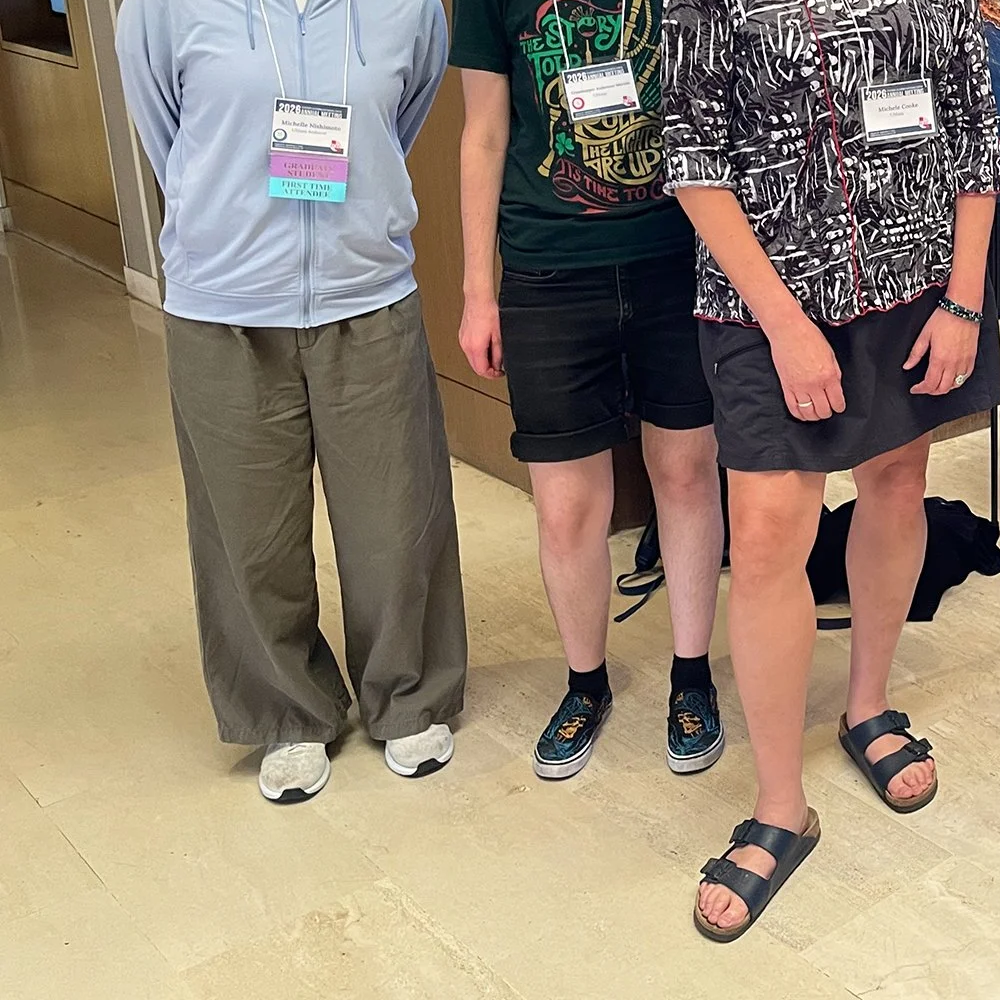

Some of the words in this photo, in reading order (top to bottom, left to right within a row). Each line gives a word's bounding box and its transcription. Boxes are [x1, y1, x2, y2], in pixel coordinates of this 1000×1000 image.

[519, 37, 545, 54] THE
[567, 72, 587, 83] 2026
[867, 89, 887, 100] 2026
[278, 102, 301, 115] 2026
[281, 119, 309, 128] Michelle
[575, 134, 611, 161] THE
[612, 124, 662, 154] LIGHTS
[584, 154, 627, 184] ARE
[628, 149, 661, 177] UP
[281, 180, 308, 189] FIRST
[623, 186, 647, 201] TO
